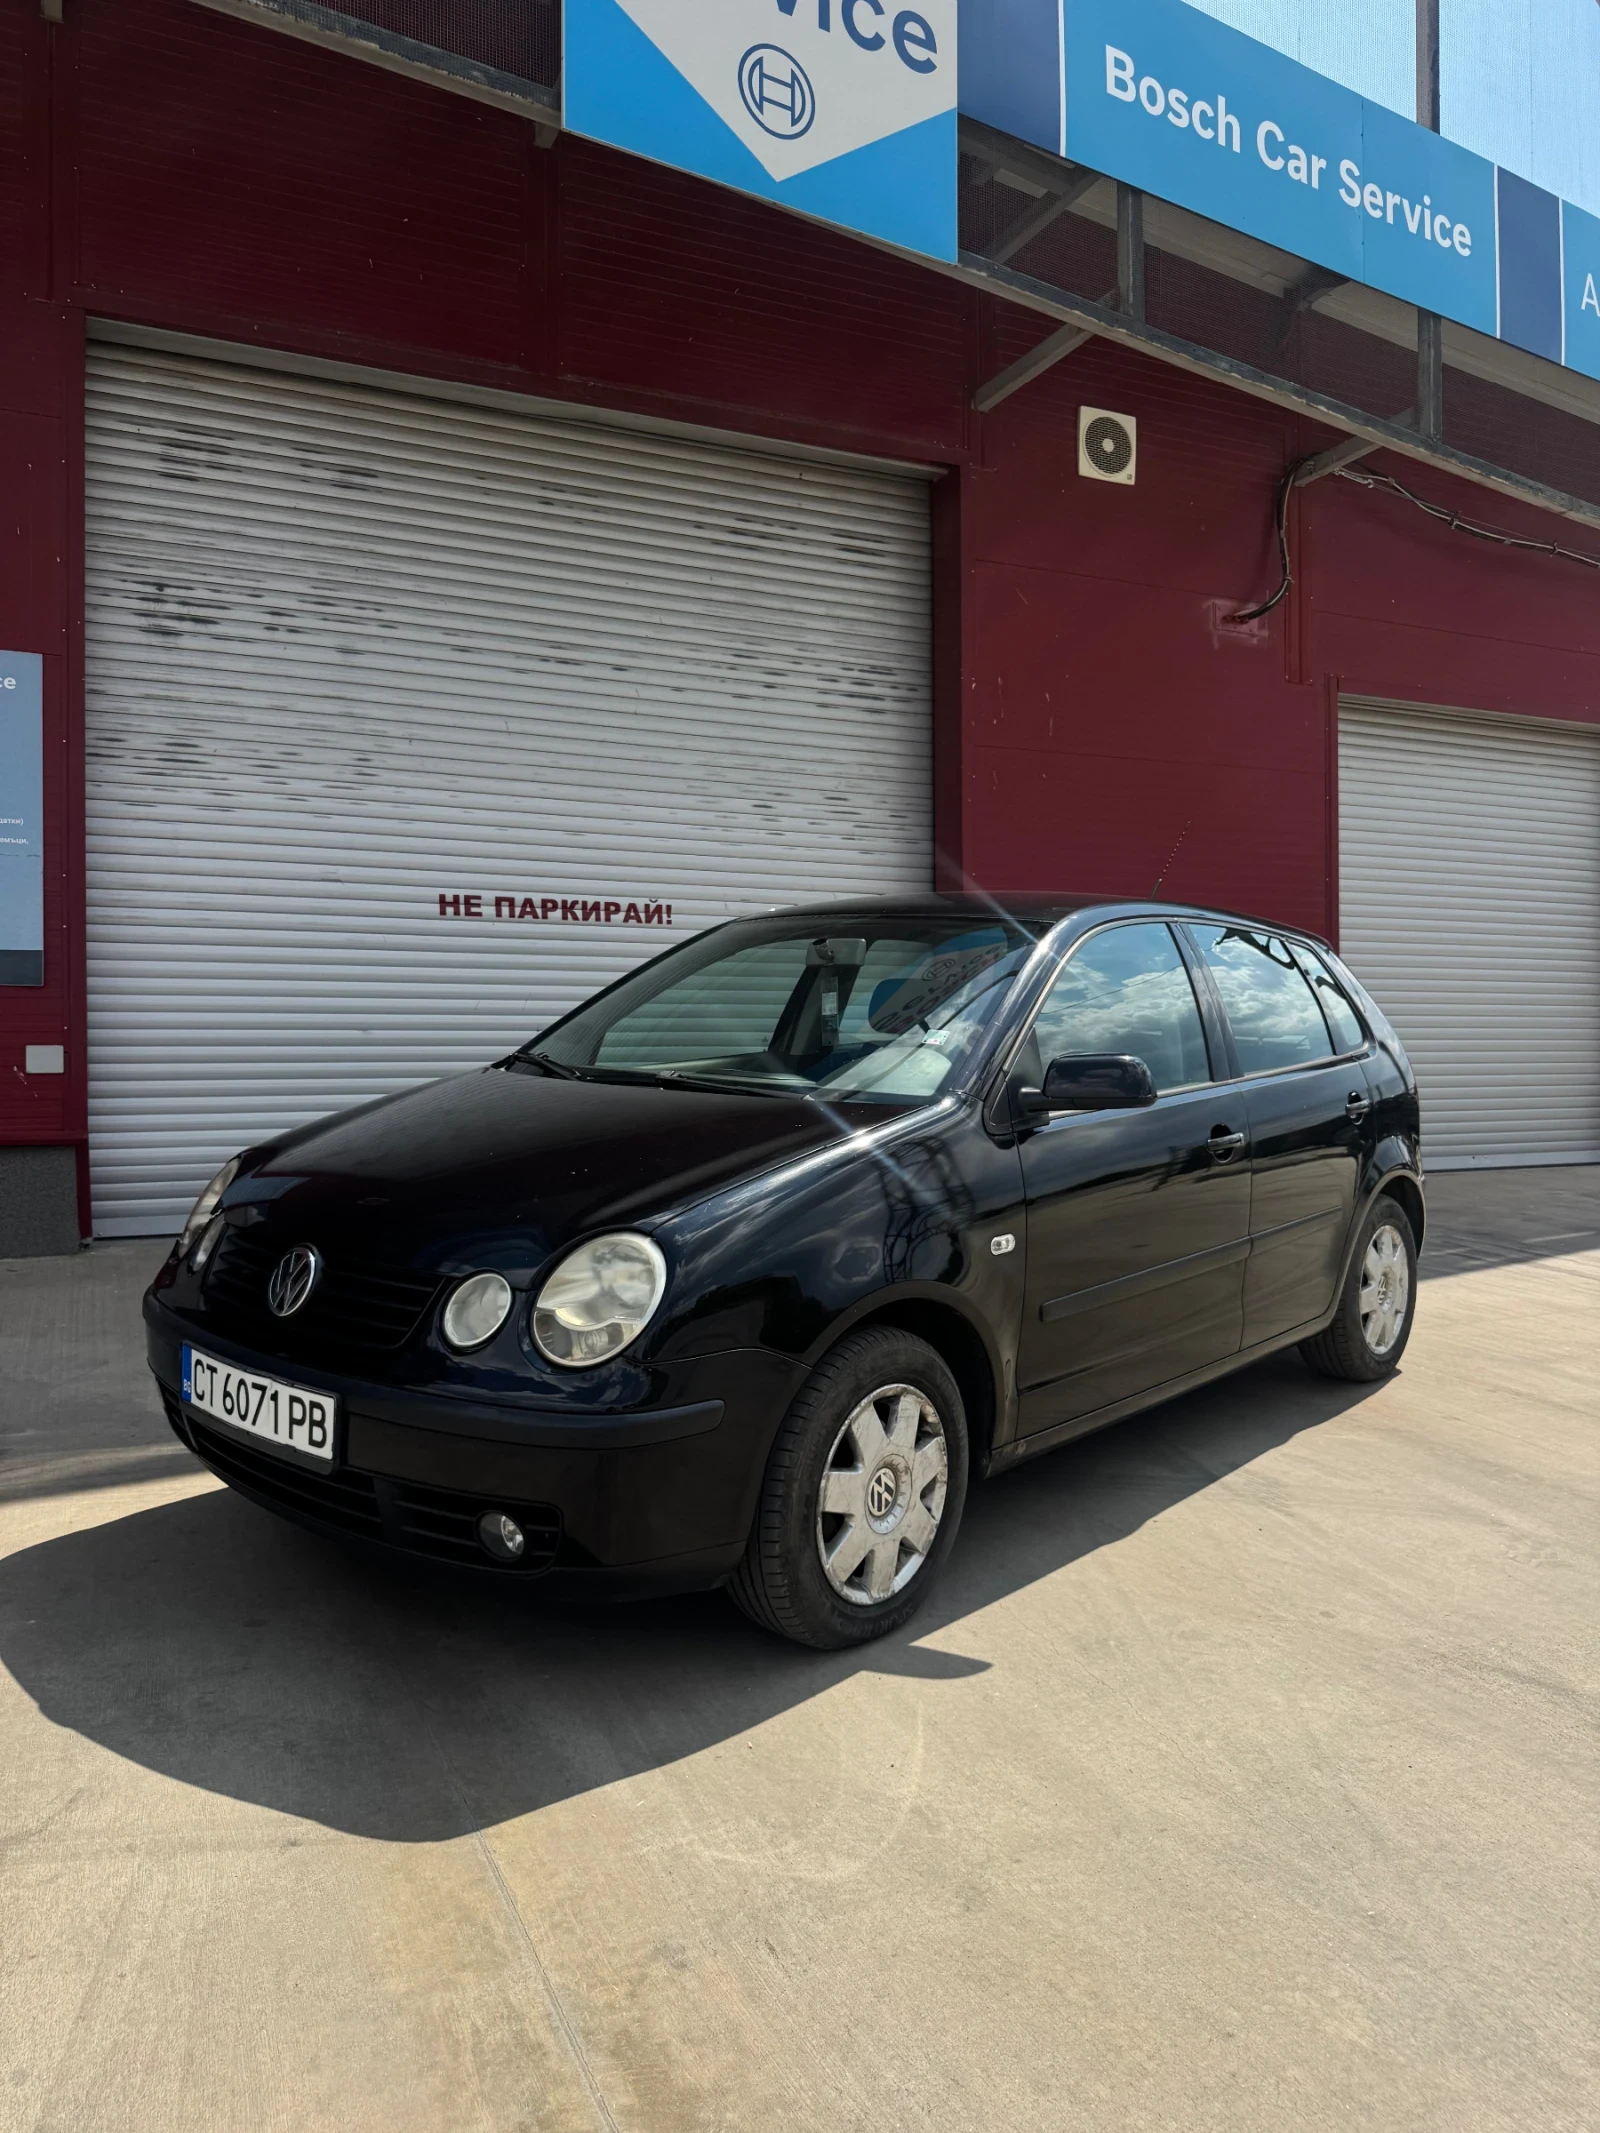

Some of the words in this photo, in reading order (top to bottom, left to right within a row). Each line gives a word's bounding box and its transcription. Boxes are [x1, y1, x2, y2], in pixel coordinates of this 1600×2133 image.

[775, 0, 938, 75] ce
[1105, 44, 1241, 153] Bosch
[1256, 120, 1327, 190] Car
[1338, 159, 1473, 257] Service
[0, 676, 17, 690] e
[438, 894, 483, 917] НЕ
[495, 896, 673, 925] ПАРКИРАЙ!
[194, 1358, 218, 1407] CT
[222, 1372, 279, 1435] 6071
[288, 1394, 328, 1449] PB
